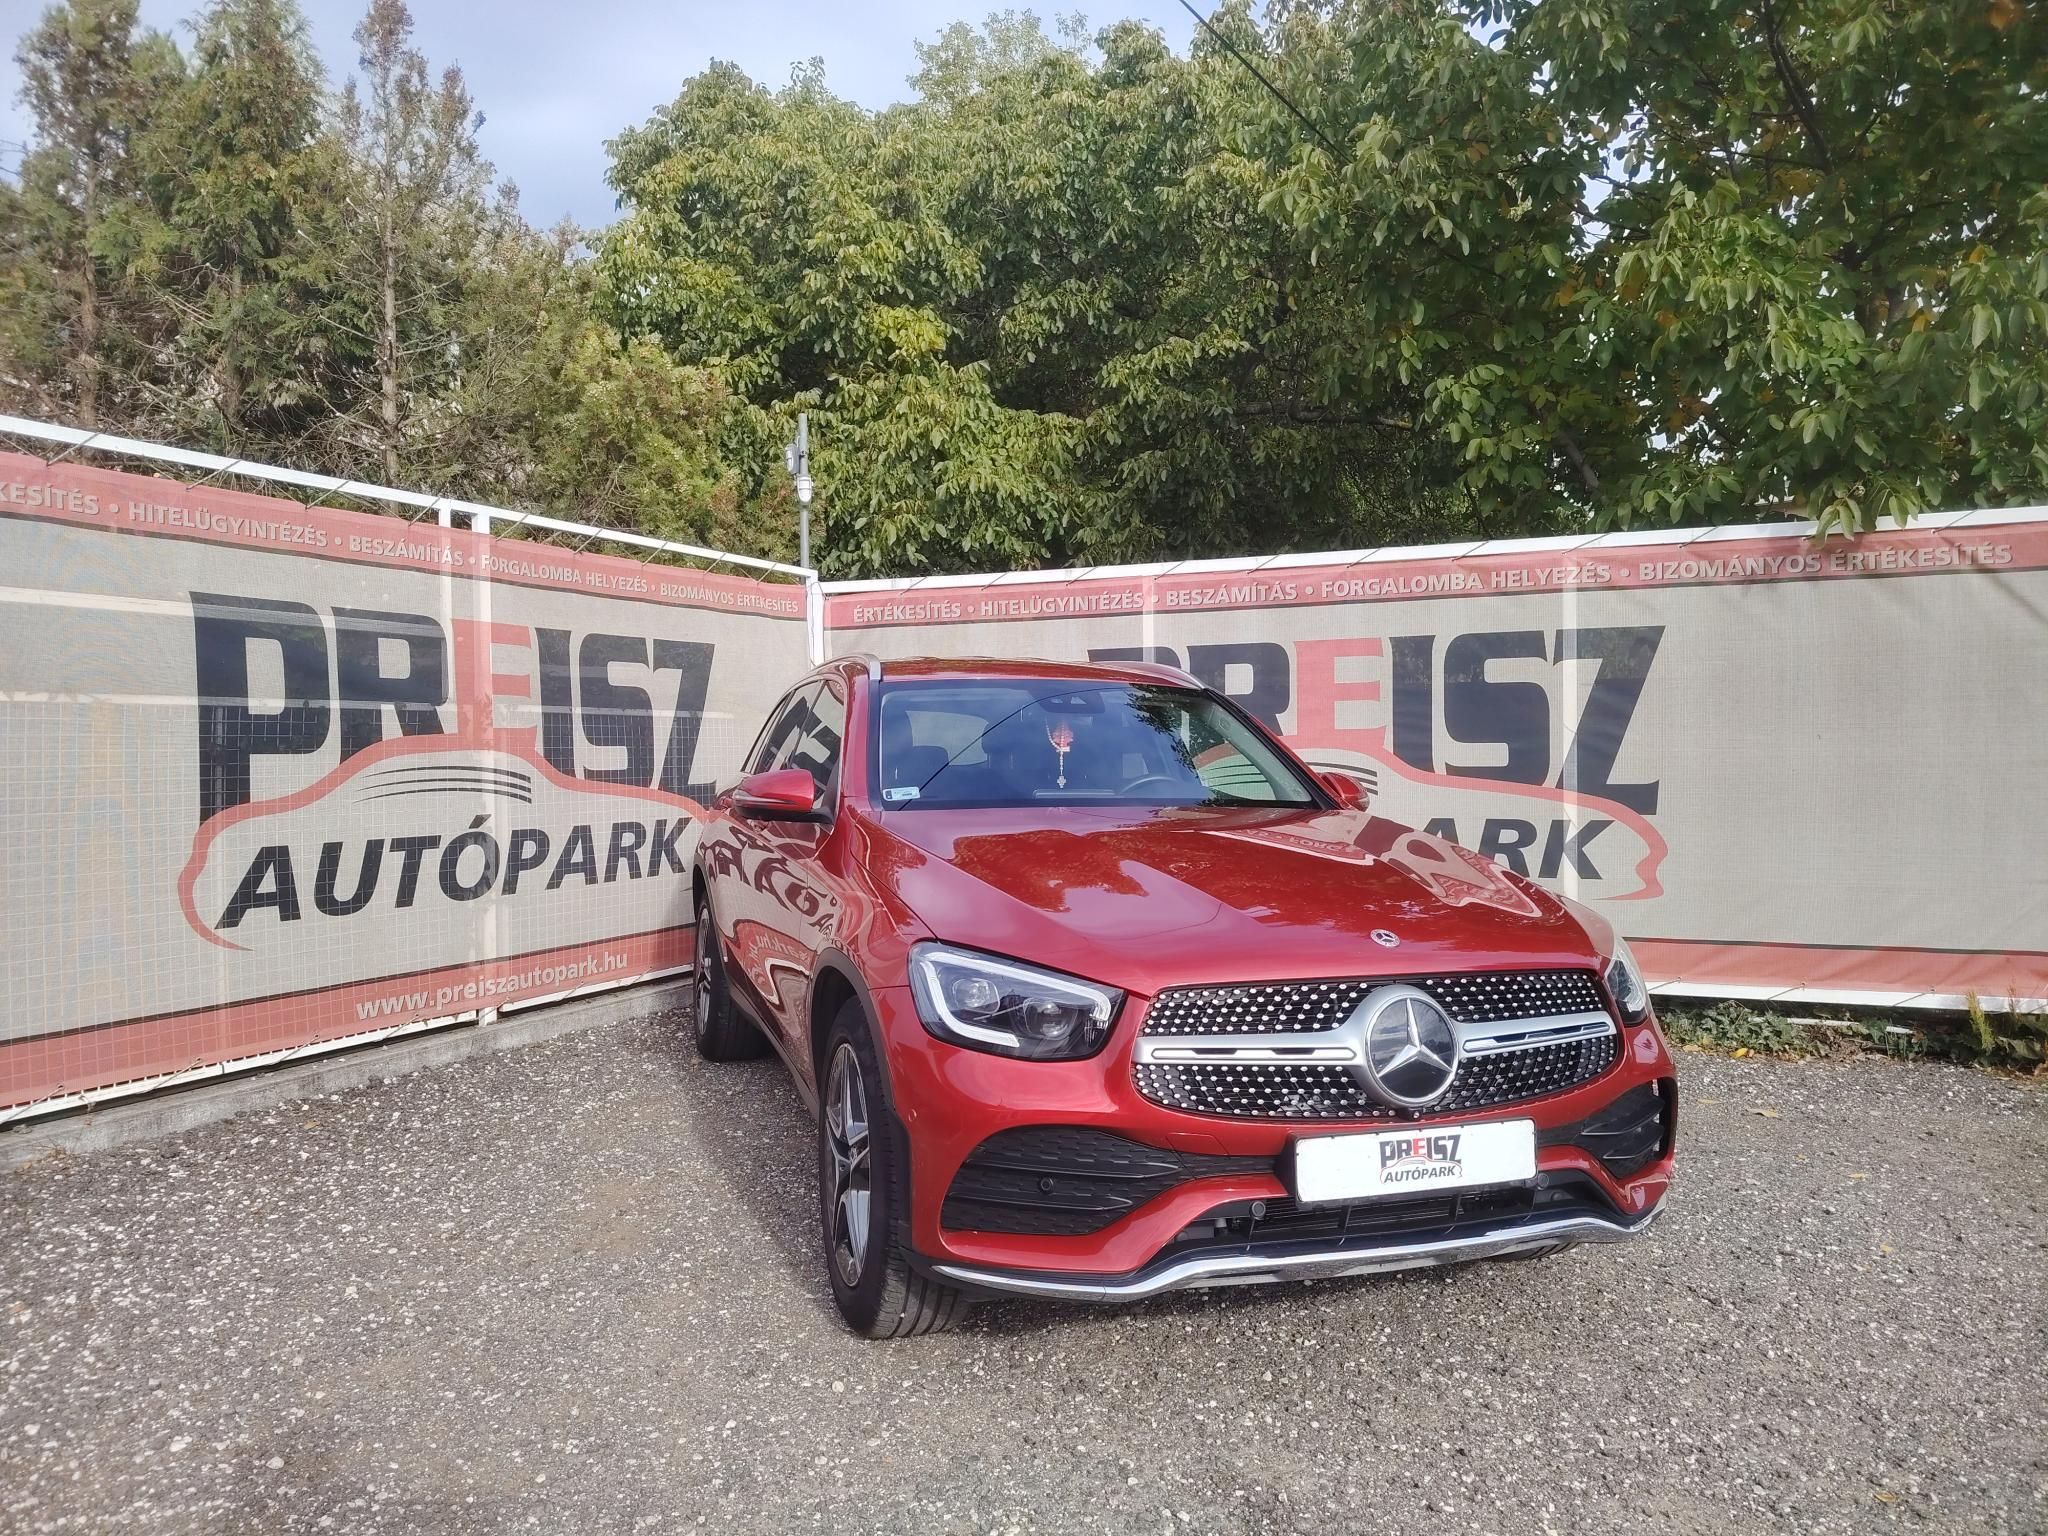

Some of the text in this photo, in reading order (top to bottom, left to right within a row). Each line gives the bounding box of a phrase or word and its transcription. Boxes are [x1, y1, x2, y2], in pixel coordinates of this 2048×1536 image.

[128, 501, 328, 547] HITELÜGYINTÉZÉS
[350, 535, 464, 567] BESZÁMÍTÁS
[481, 554, 583, 584] FORGALOMBA
[586, 572, 648, 593] HELYEZÉS
[661, 584, 734, 606] BIZOMÁNYOS
[737, 591, 799, 613] ÉRTÉKESÍTÉS
[853, 543, 2012, 623] ÉRTÉKESÍTÉS HITELÜGYINTÉZÉS BESZÁMÍTÁS FORGALOMBA HELYEZÉS BIZOMÁNYOS ÉRTÉKESÍTÉS
[189, 591, 717, 825] PREISZ
[1087, 625, 1666, 815] REISZ
[215, 814, 692, 930] AUTÓPARK
[356, 951, 628, 1020] www.preiszautopark.hu
[1379, 1134, 1462, 1169] PREISZ
[1384, 1165, 1457, 1183] AUTÓPARK
